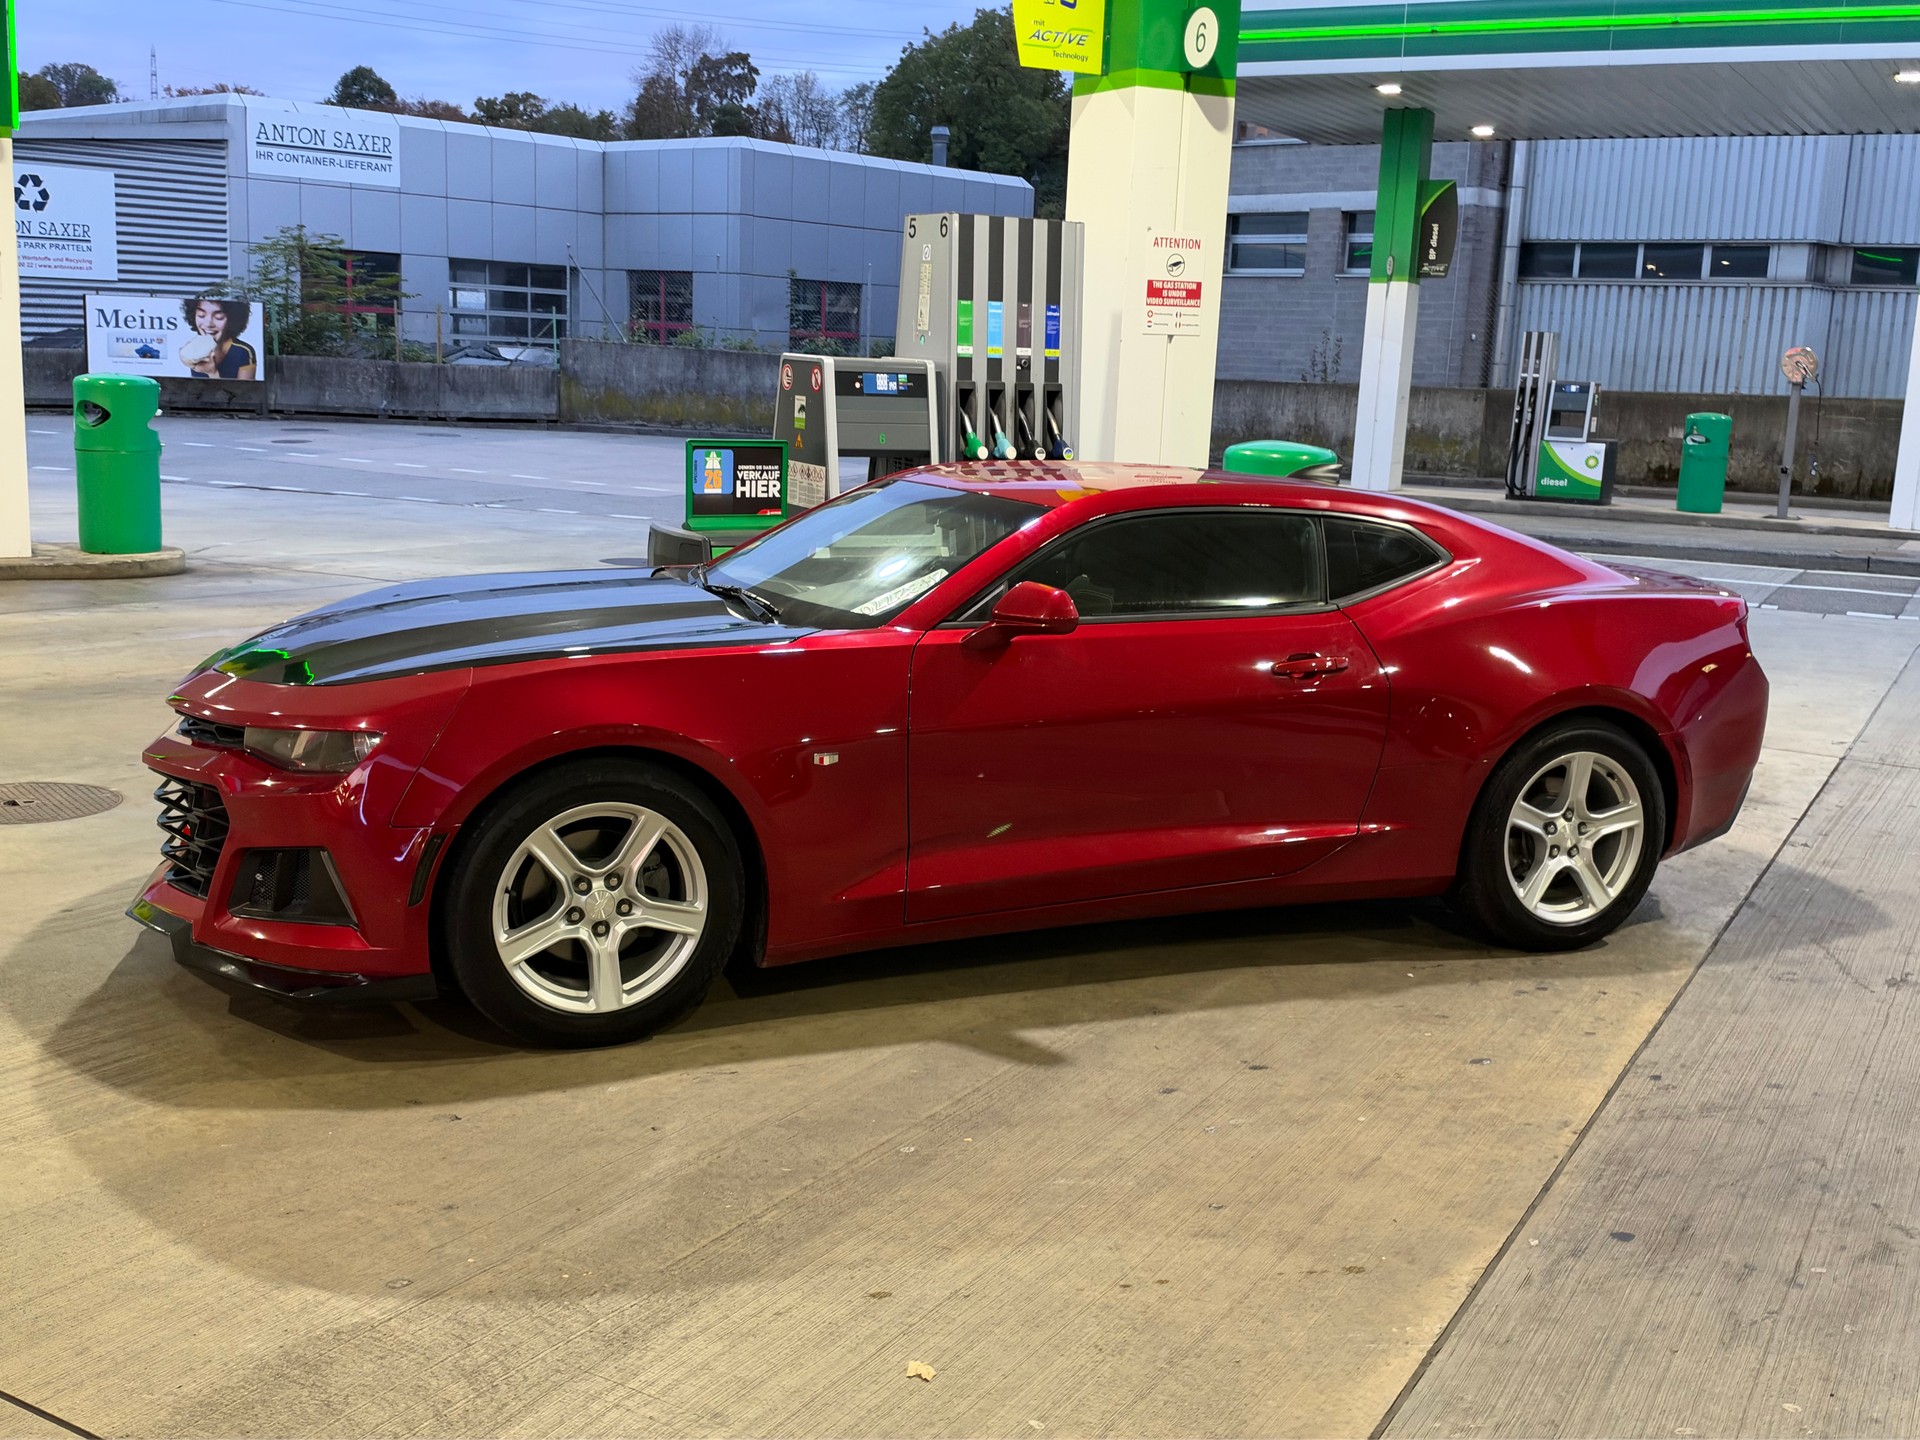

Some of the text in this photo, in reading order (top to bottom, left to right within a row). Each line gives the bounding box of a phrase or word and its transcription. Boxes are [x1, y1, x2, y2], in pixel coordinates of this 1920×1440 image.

[1033, 18, 1045, 27] mit
[1028, 28, 1089, 47] ACTIVE
[1195, 21, 1207, 53] 6
[1052, 49, 1089, 62] Technology
[255, 122, 393, 154] ANTON SAXER
[255, 150, 393, 173] IHR CONTAINER-LIEFERANT
[38, 221, 92, 239] SAXER
[908, 215, 948, 239] 5 6
[23, 241, 48, 250] PARK
[49, 243, 93, 253] PRATTELN
[1153, 236, 1202, 250] ATTENTION
[1428, 223, 1439, 260] BP diesel
[1152, 280, 1197, 290] THE GAS STATION
[1162, 289, 1187, 298] IS UNDER
[1146, 297, 1201, 307] VIDEO SURVEILLANCE
[95, 307, 179, 331] Meins
[115, 336, 156, 345] FLORALP
[879, 433, 887, 445] 6
[704, 469, 723, 490] 26
[736, 470, 781, 480] VERKAUF
[1540, 477, 1568, 487] diesel
[736, 480, 781, 498] HIER
